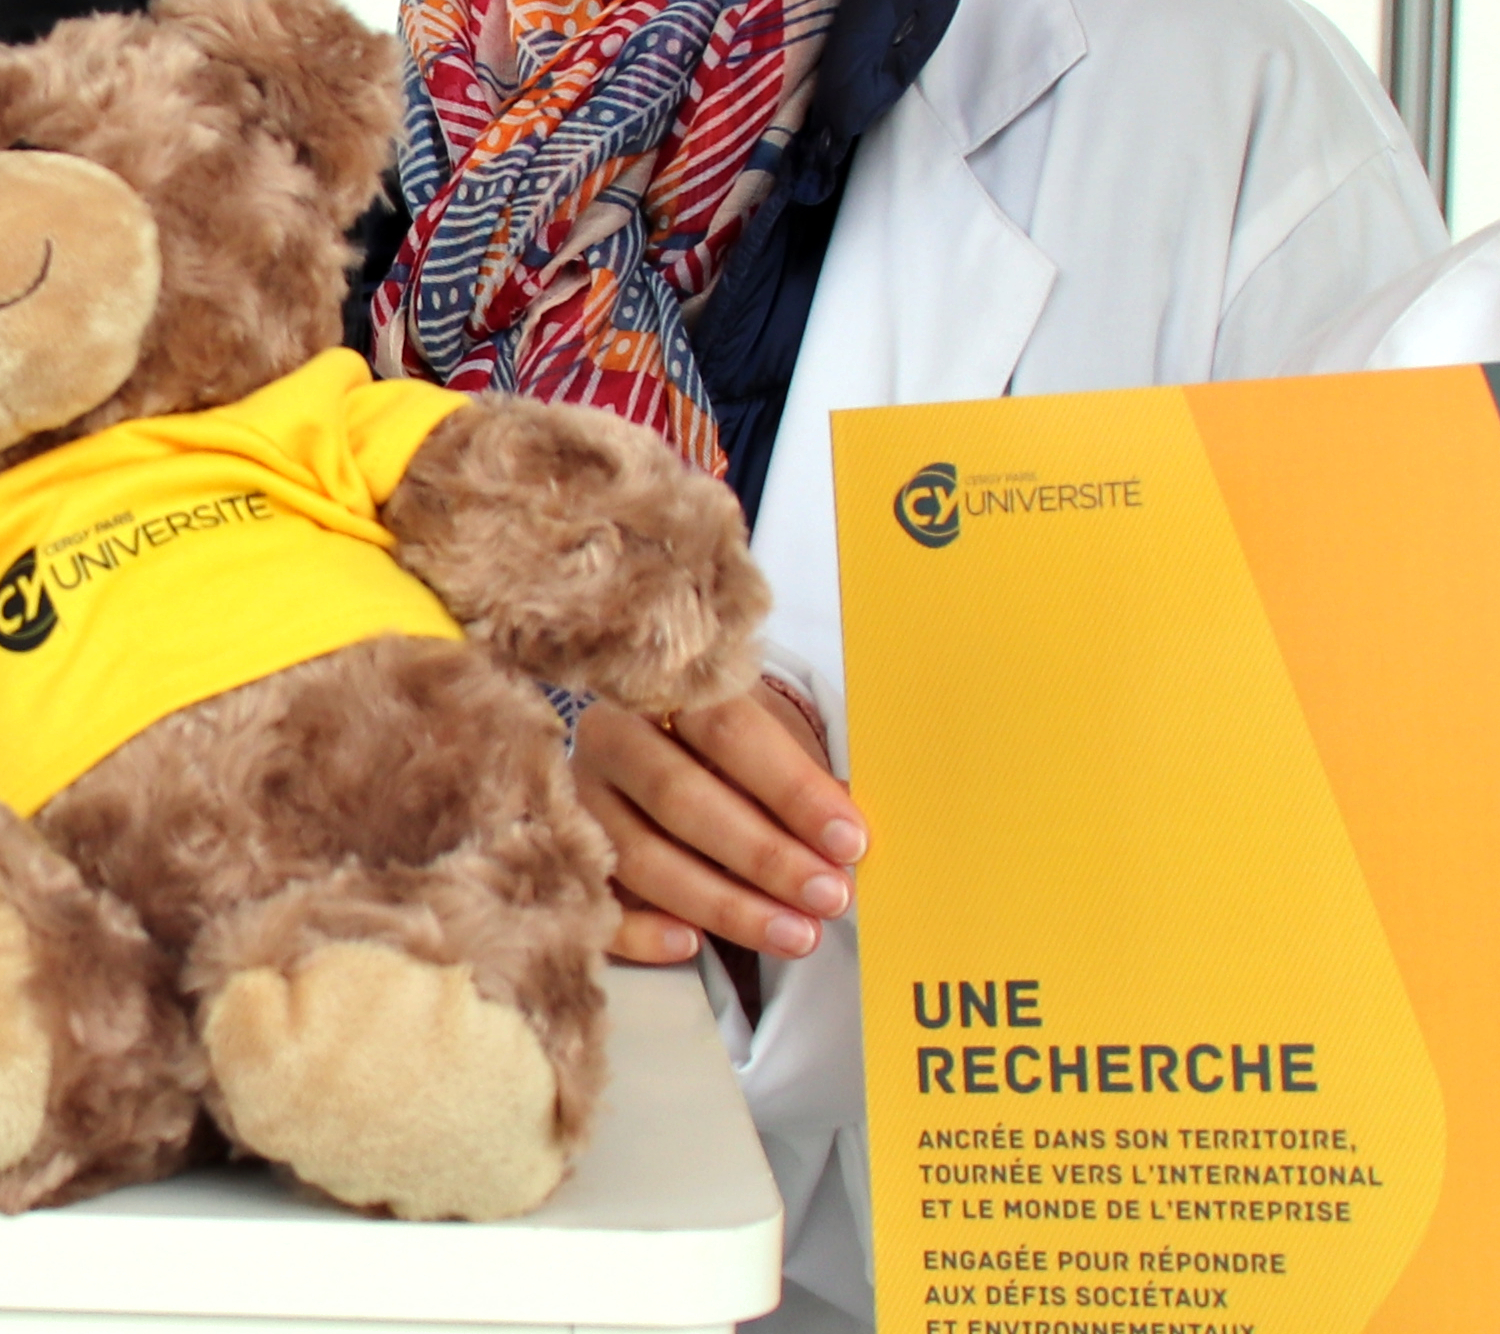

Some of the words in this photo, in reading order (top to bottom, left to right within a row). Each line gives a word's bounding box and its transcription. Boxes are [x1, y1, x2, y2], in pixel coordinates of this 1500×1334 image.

[965, 476, 1143, 516] UNIVERSITÉ
[913, 979, 1042, 1029] UNE
[916, 1043, 1318, 1094] RECHERCHE
[918, 1122, 1024, 1150] ANCRÉE
[1034, 1129, 1105, 1149] DANS
[1116, 1129, 1168, 1149] SON
[1178, 1129, 1357, 1153] TERRITOIRE,
[919, 1158, 1043, 1184] TOURNÉE
[1052, 1164, 1122, 1184] VERS
[1133, 1164, 1383, 1187] L'INTERNATIONAL
[921, 1199, 952, 1219] ET
[963, 1200, 993, 1219] LE
[1004, 1200, 1096, 1219] MONDE
[1107, 1200, 1140, 1219] DE
[1151, 1200, 1352, 1222] L'ENTREPRISE
[923, 1245, 1048, 1271] ENGAGÉE
[1058, 1251, 1129, 1271] POUR
[1140, 1247, 1287, 1274] RÉPONDRE
[924, 1286, 976, 1305] AUX
[987, 1280, 1067, 1306] DÉFIS
[1076, 1282, 1228, 1308] SOCIÉTAUX
